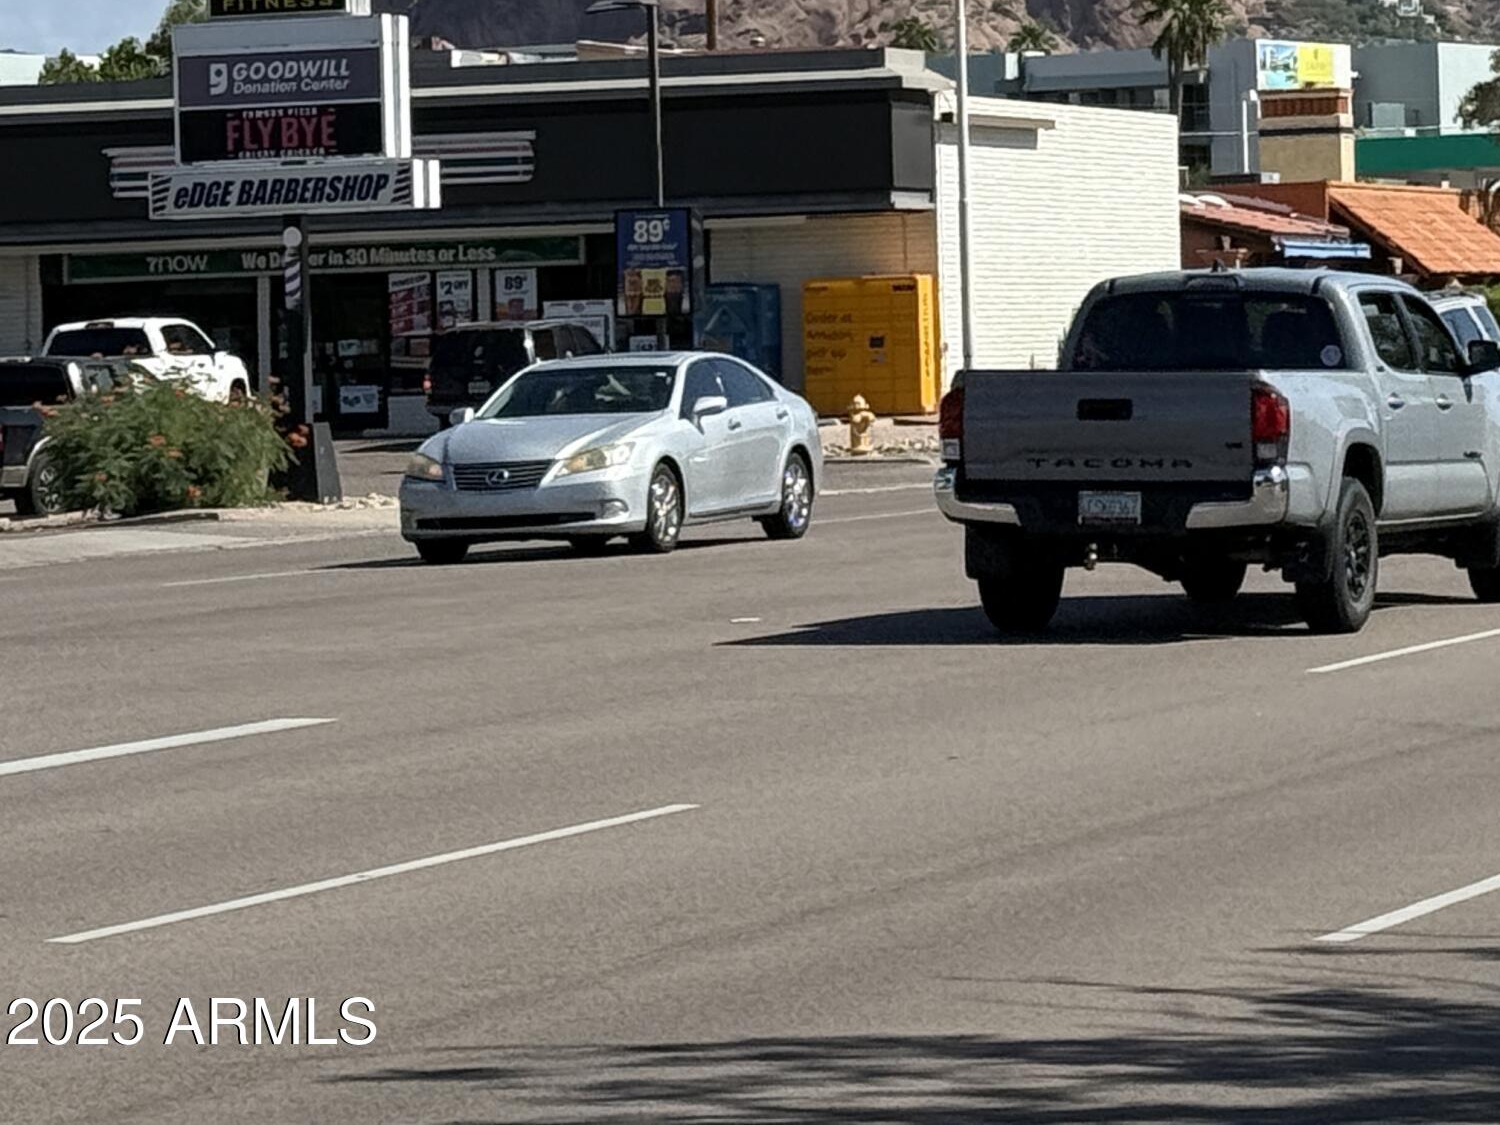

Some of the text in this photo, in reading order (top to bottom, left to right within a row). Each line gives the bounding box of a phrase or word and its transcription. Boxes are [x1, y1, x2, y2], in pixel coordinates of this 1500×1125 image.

[232, 58, 350, 81] GOODWILL
[233, 77, 350, 95] Donation Center
[226, 114, 338, 152] FLY BYE
[236, 174, 390, 207] BARBERSHOP
[241, 251, 267, 269] We
[328, 249, 344, 265] in
[346, 248, 367, 265] 30
[369, 246, 436, 264] Minutes
[438, 249, 456, 262] or
[458, 245, 496, 262] Less
[1026, 457, 1193, 470] TACOMA
